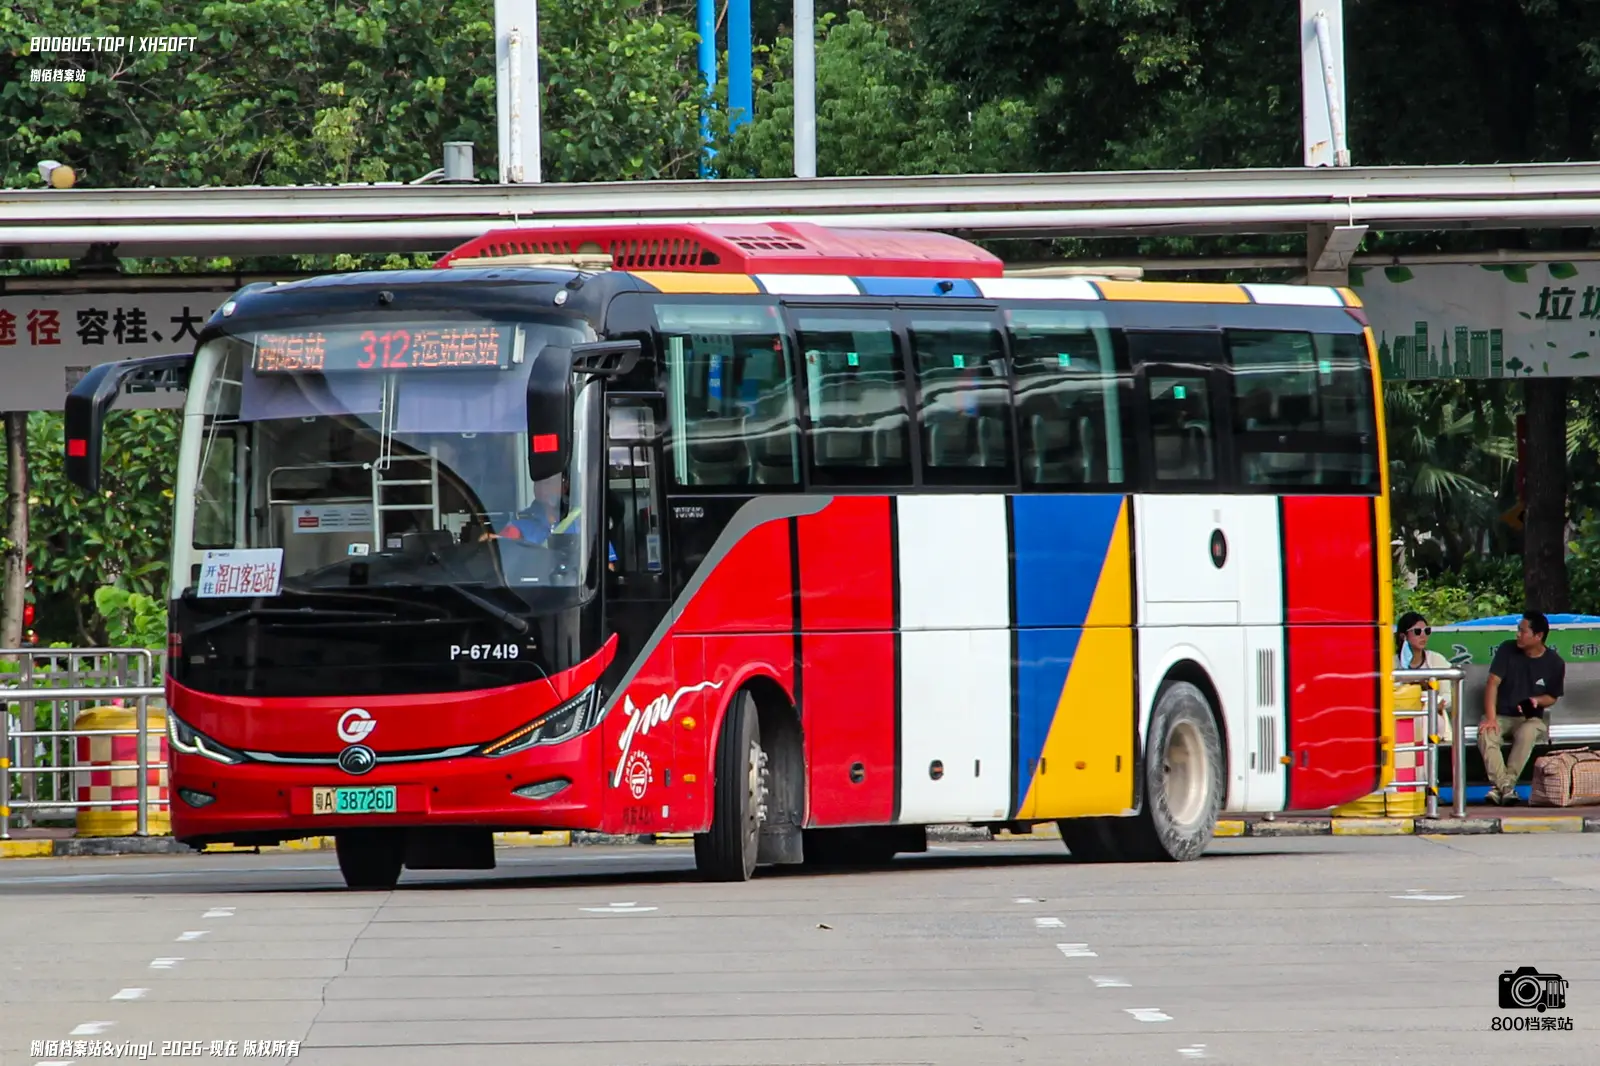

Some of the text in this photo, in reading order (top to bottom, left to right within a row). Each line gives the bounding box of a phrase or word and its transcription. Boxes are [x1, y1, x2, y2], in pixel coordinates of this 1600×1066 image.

[76, 307, 214, 345] 容桂、大
[357, 329, 411, 369] 312
[450, 643, 519, 660] P-67419
